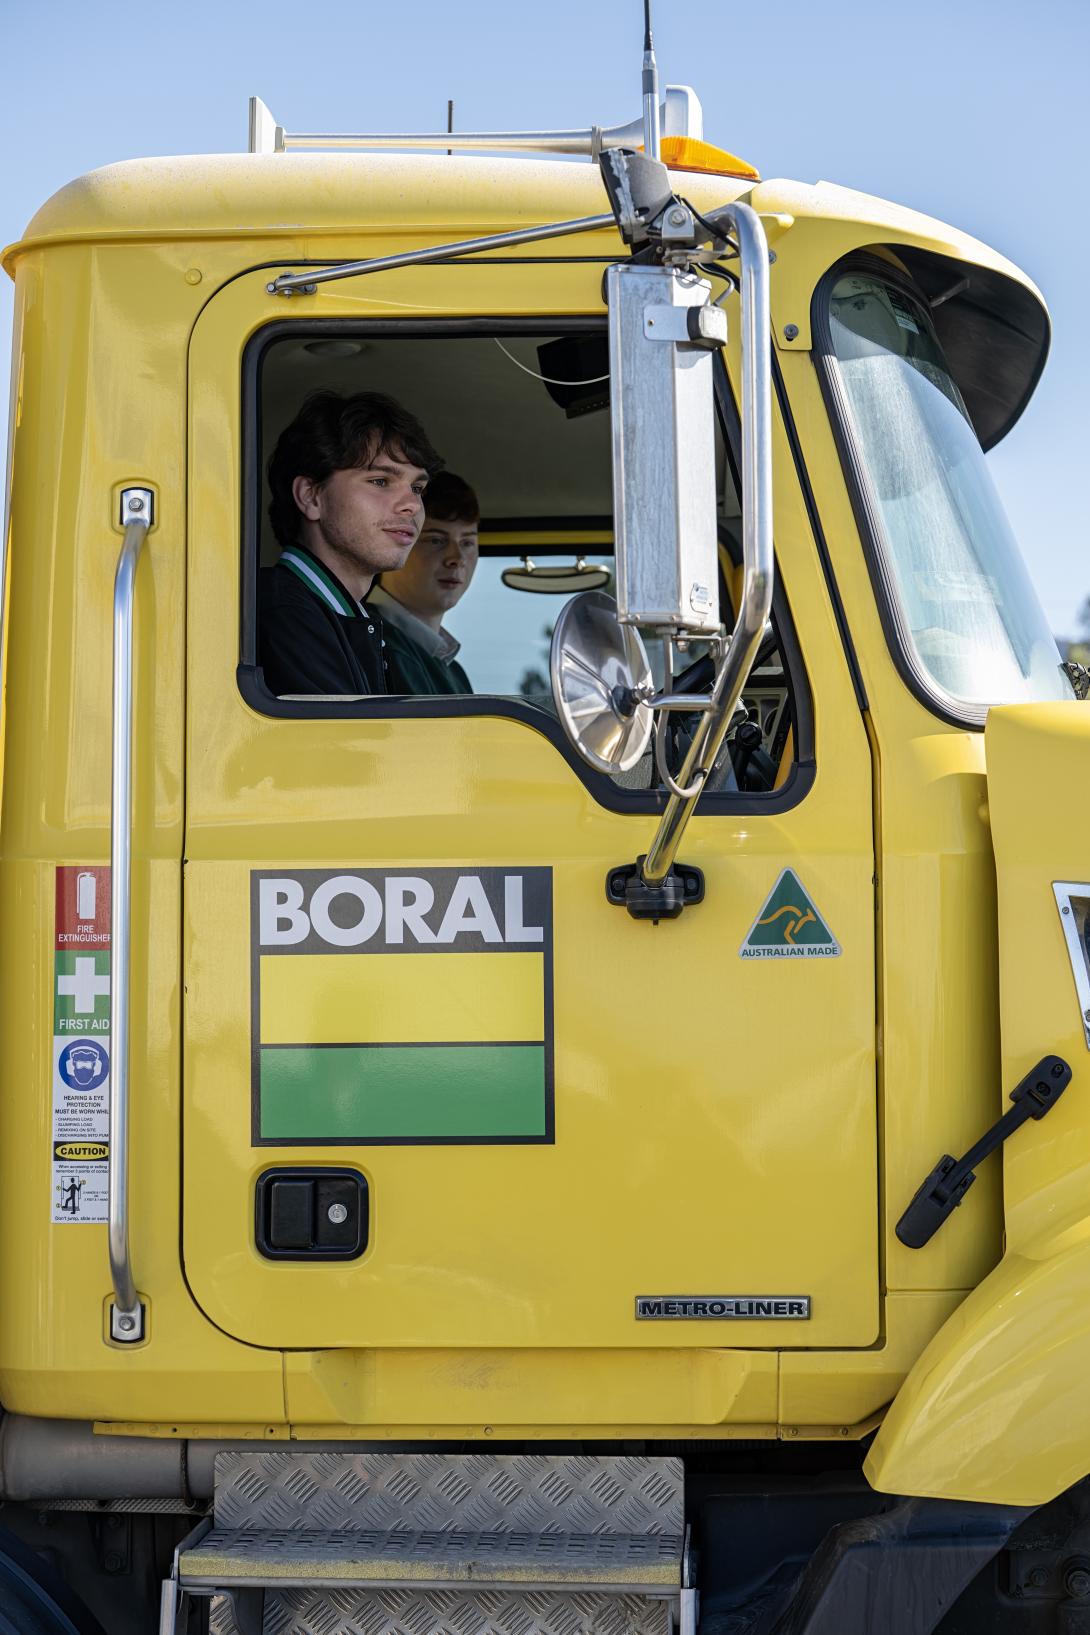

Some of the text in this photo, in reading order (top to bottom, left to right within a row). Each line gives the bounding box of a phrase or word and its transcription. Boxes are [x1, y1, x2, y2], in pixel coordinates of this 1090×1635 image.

[259, 875, 544, 946] BORAL
[77, 925, 94, 933] FIRE
[742, 946, 838, 957] AUSTRALIAN MADE
[59, 1018, 109, 1030] FIRST AID
[60, 1147, 106, 1156] CAUTION
[641, 1302, 804, 1315] METRO-LINER
